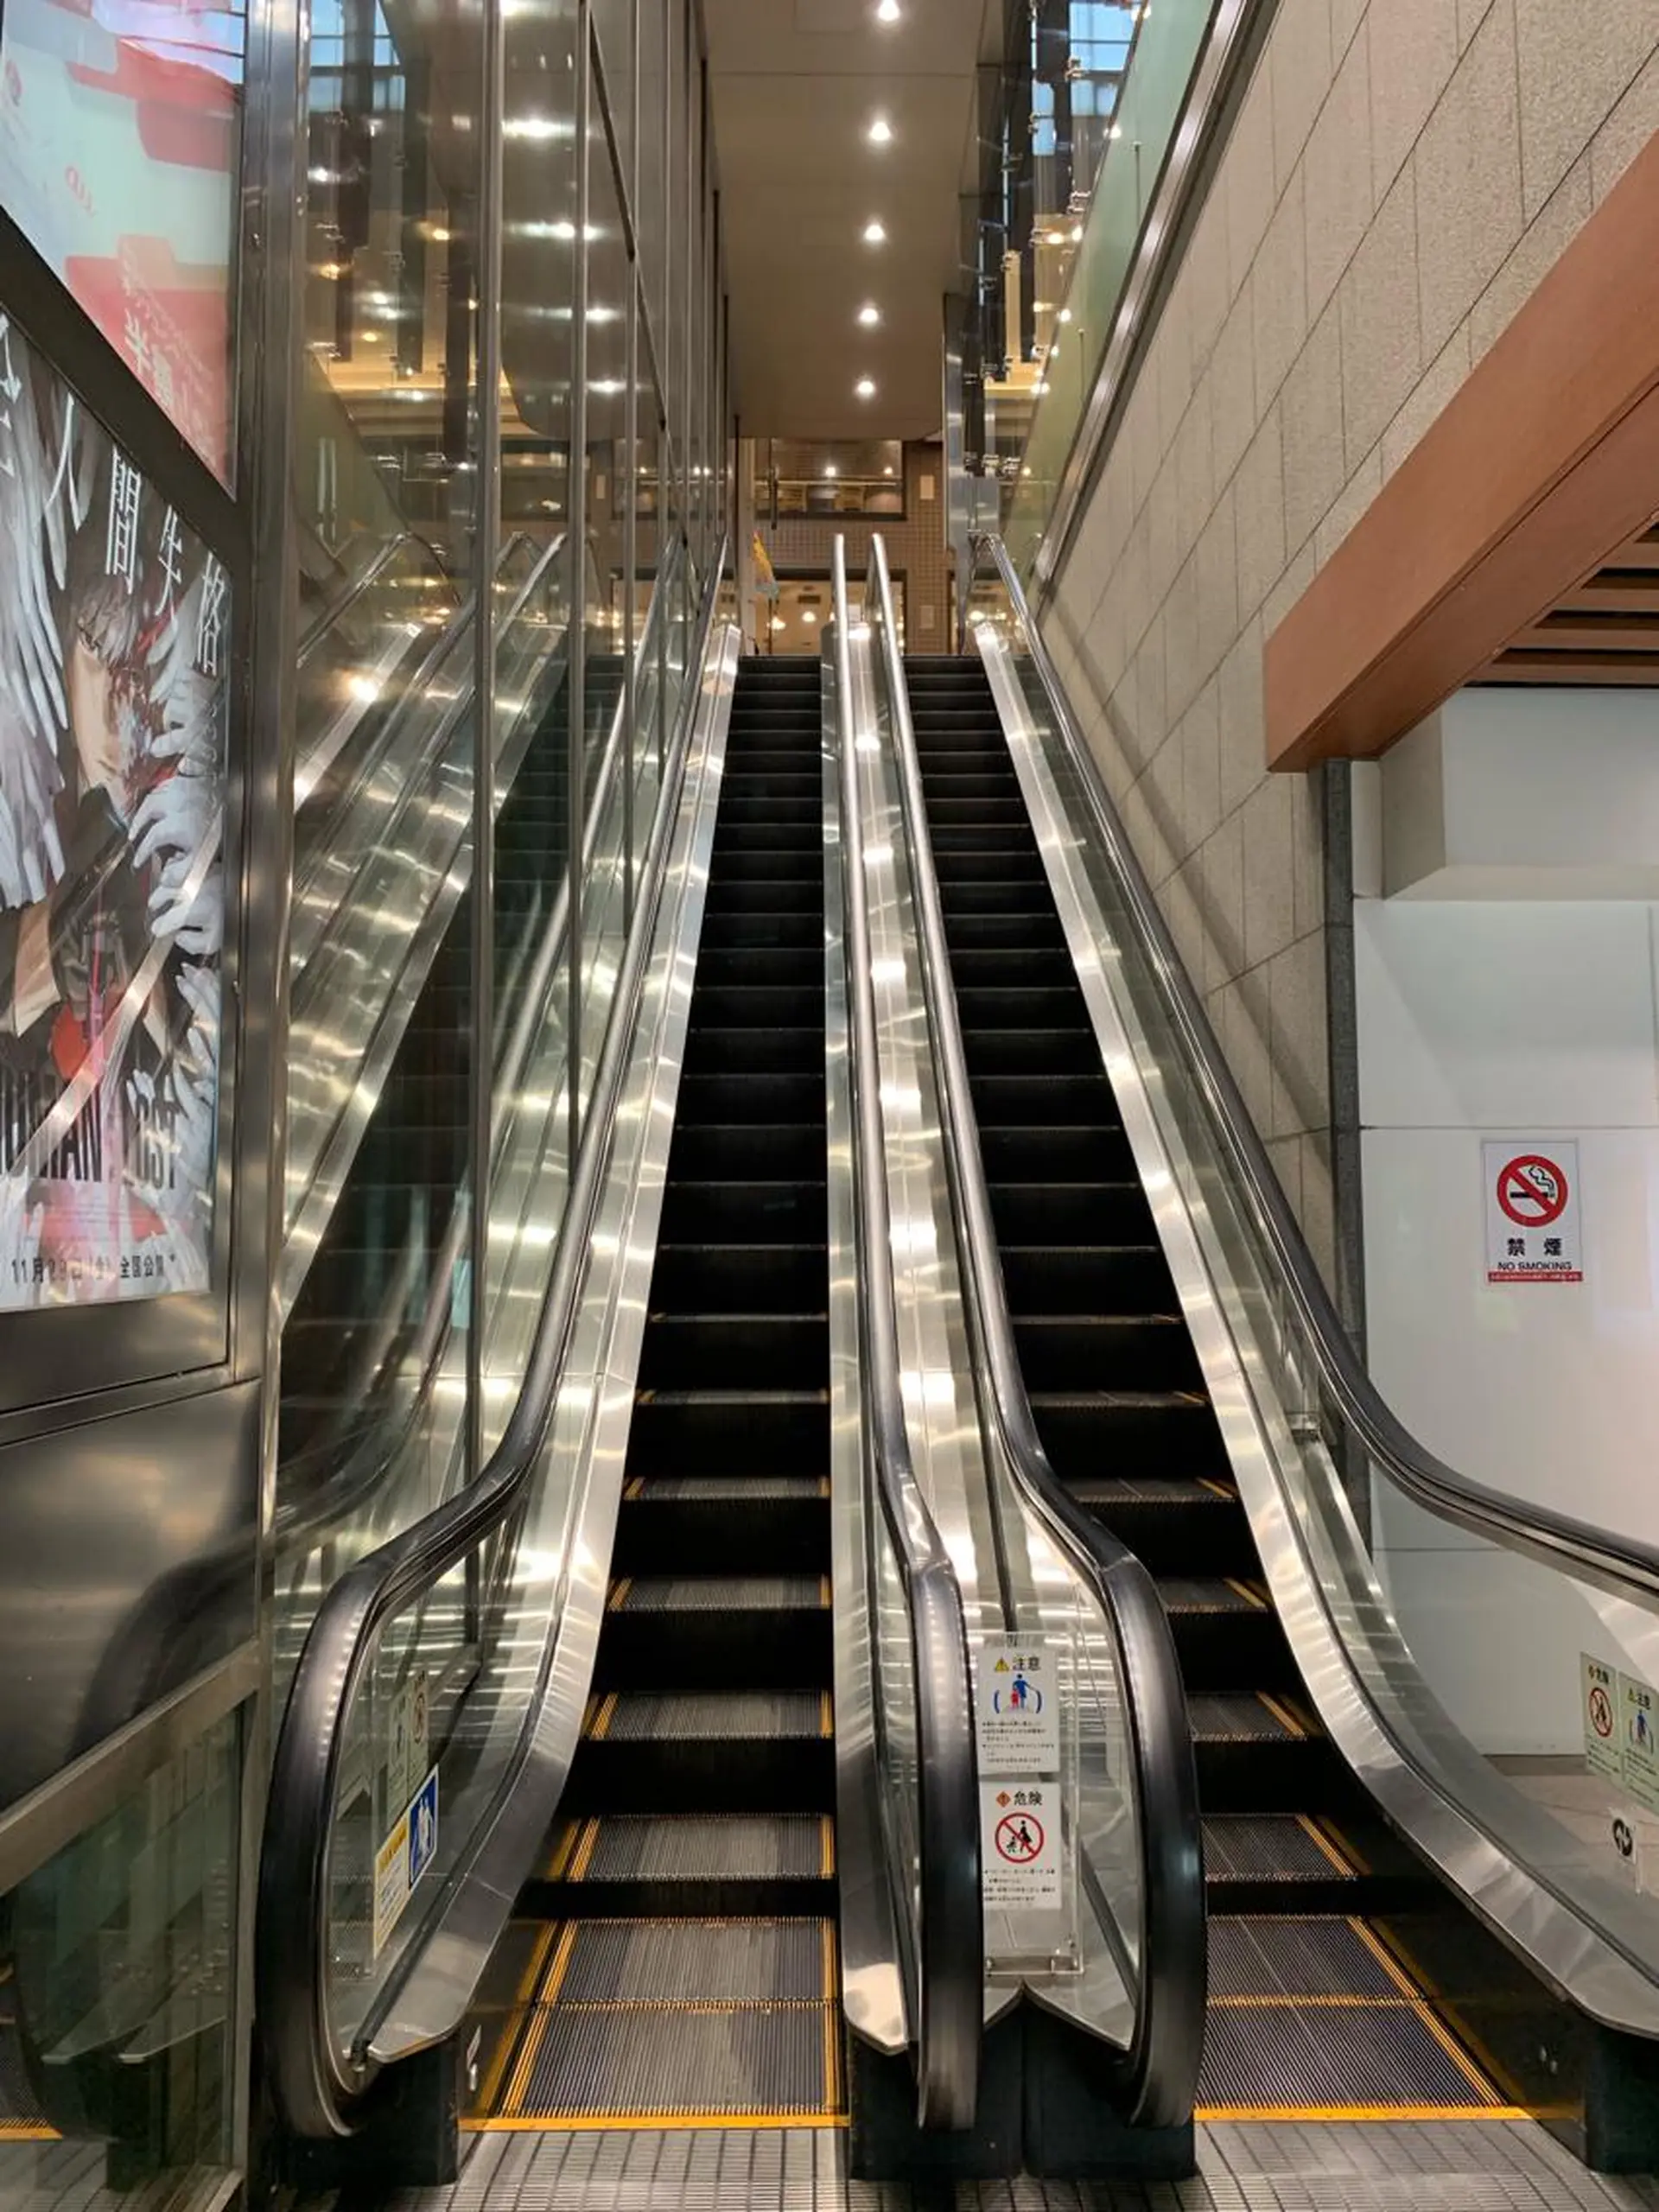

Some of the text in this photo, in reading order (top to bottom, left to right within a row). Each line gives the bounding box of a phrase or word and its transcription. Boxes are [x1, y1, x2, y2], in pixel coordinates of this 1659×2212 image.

[1497, 1262, 1572, 1270] NO SMOKING
[1012, 1656, 1040, 1671] 注意
[1014, 1790, 1042, 1806] 危険
